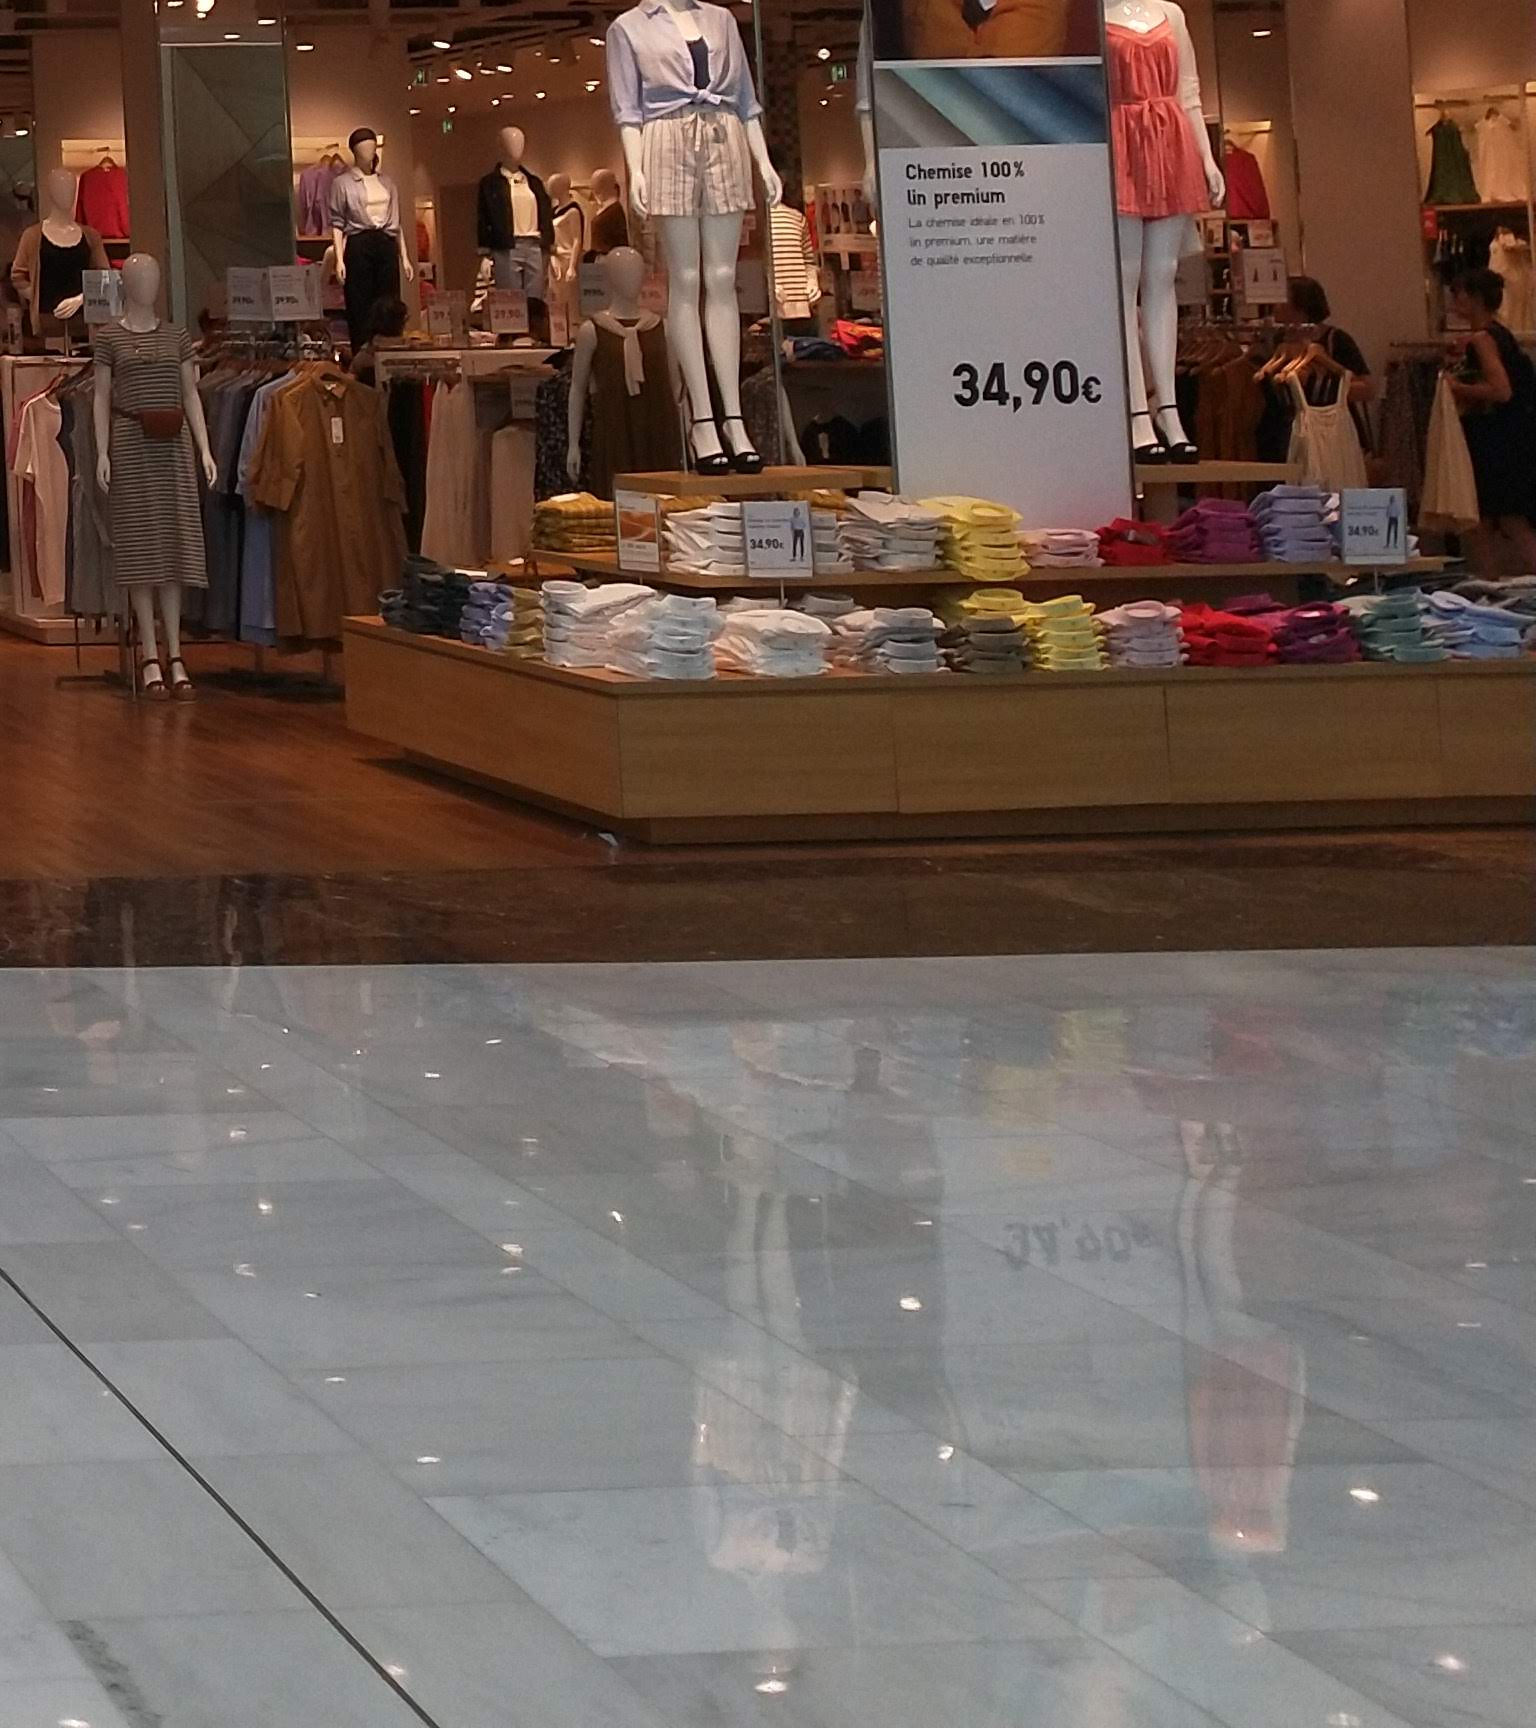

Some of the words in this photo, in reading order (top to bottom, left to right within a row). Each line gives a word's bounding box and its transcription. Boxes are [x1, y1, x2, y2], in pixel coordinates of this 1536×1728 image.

[905, 163, 973, 180] Chemise
[907, 189, 926, 206] lin
[934, 188, 1006, 209] premium
[908, 216, 923, 228] La
[952, 360, 1102, 413] 34,90€
